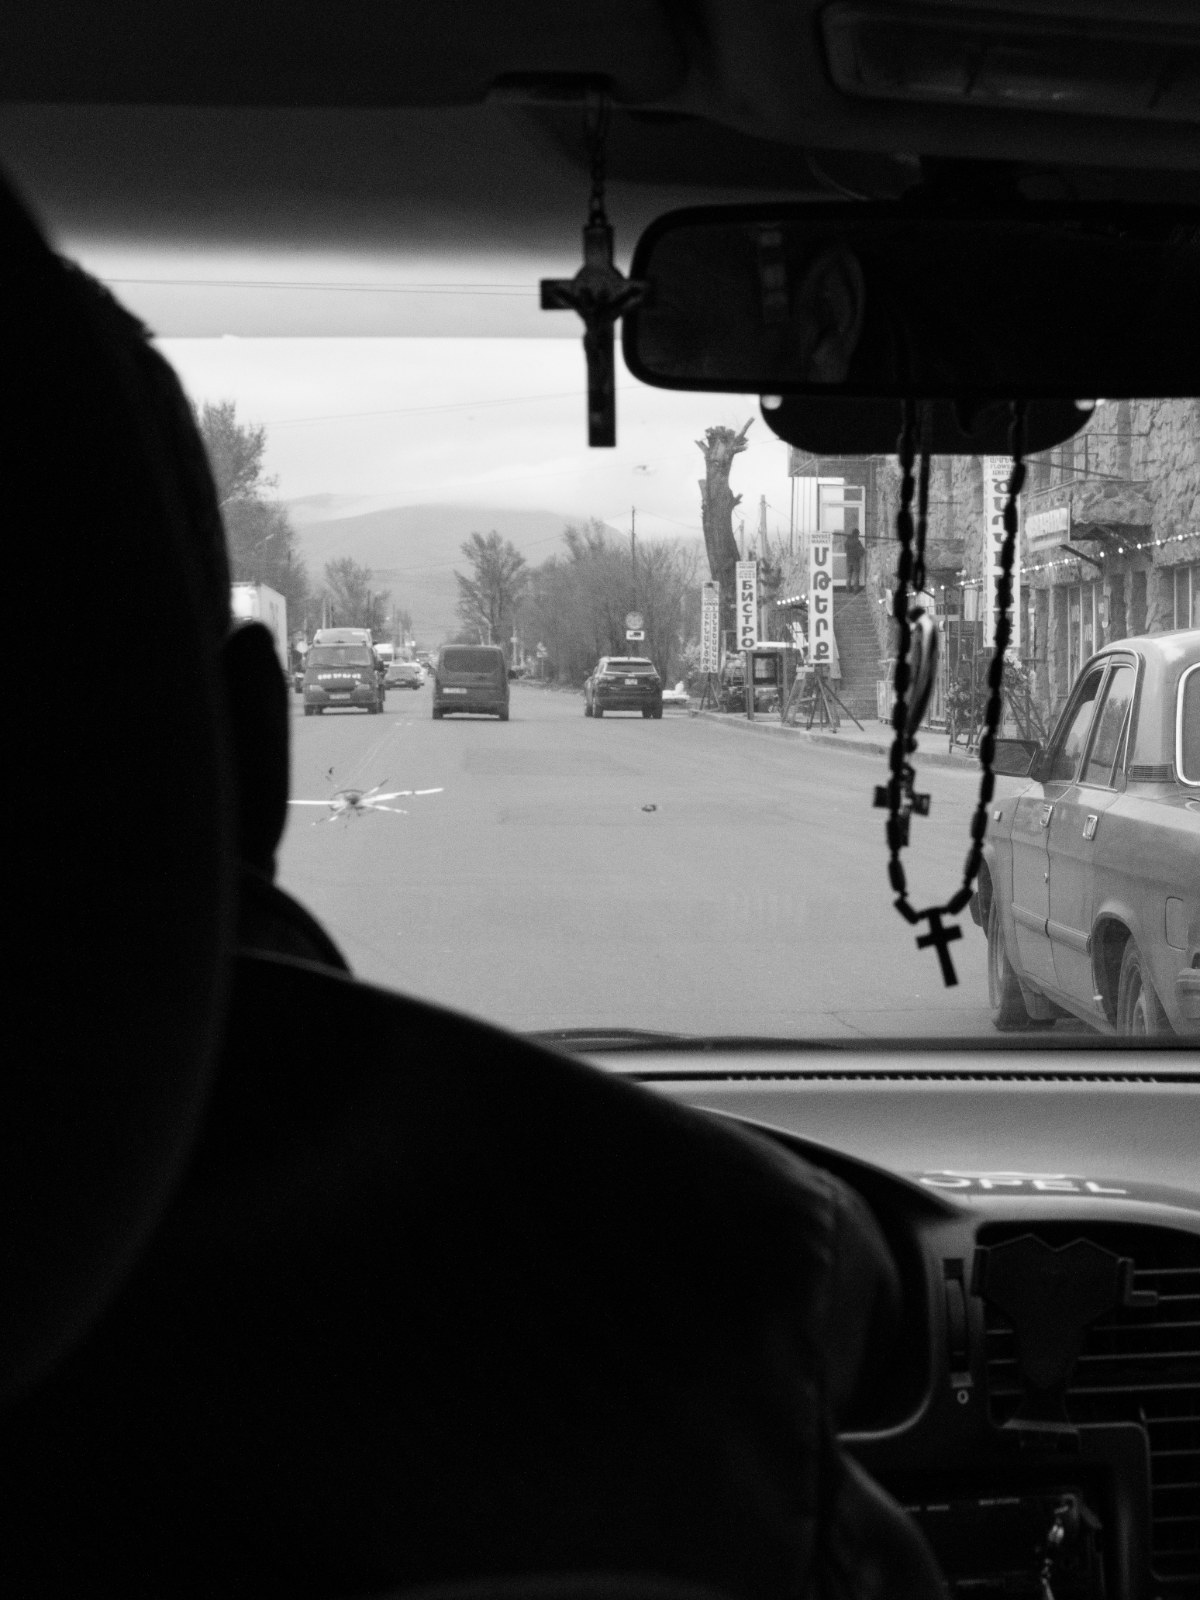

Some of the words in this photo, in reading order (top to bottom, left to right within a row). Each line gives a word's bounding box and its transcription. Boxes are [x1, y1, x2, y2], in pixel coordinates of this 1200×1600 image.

[741, 580, 755, 648] БИСТРО
[813, 547, 831, 661] ՄԹԵՐՔ
[919, 1176, 1127, 1194] OPEL
